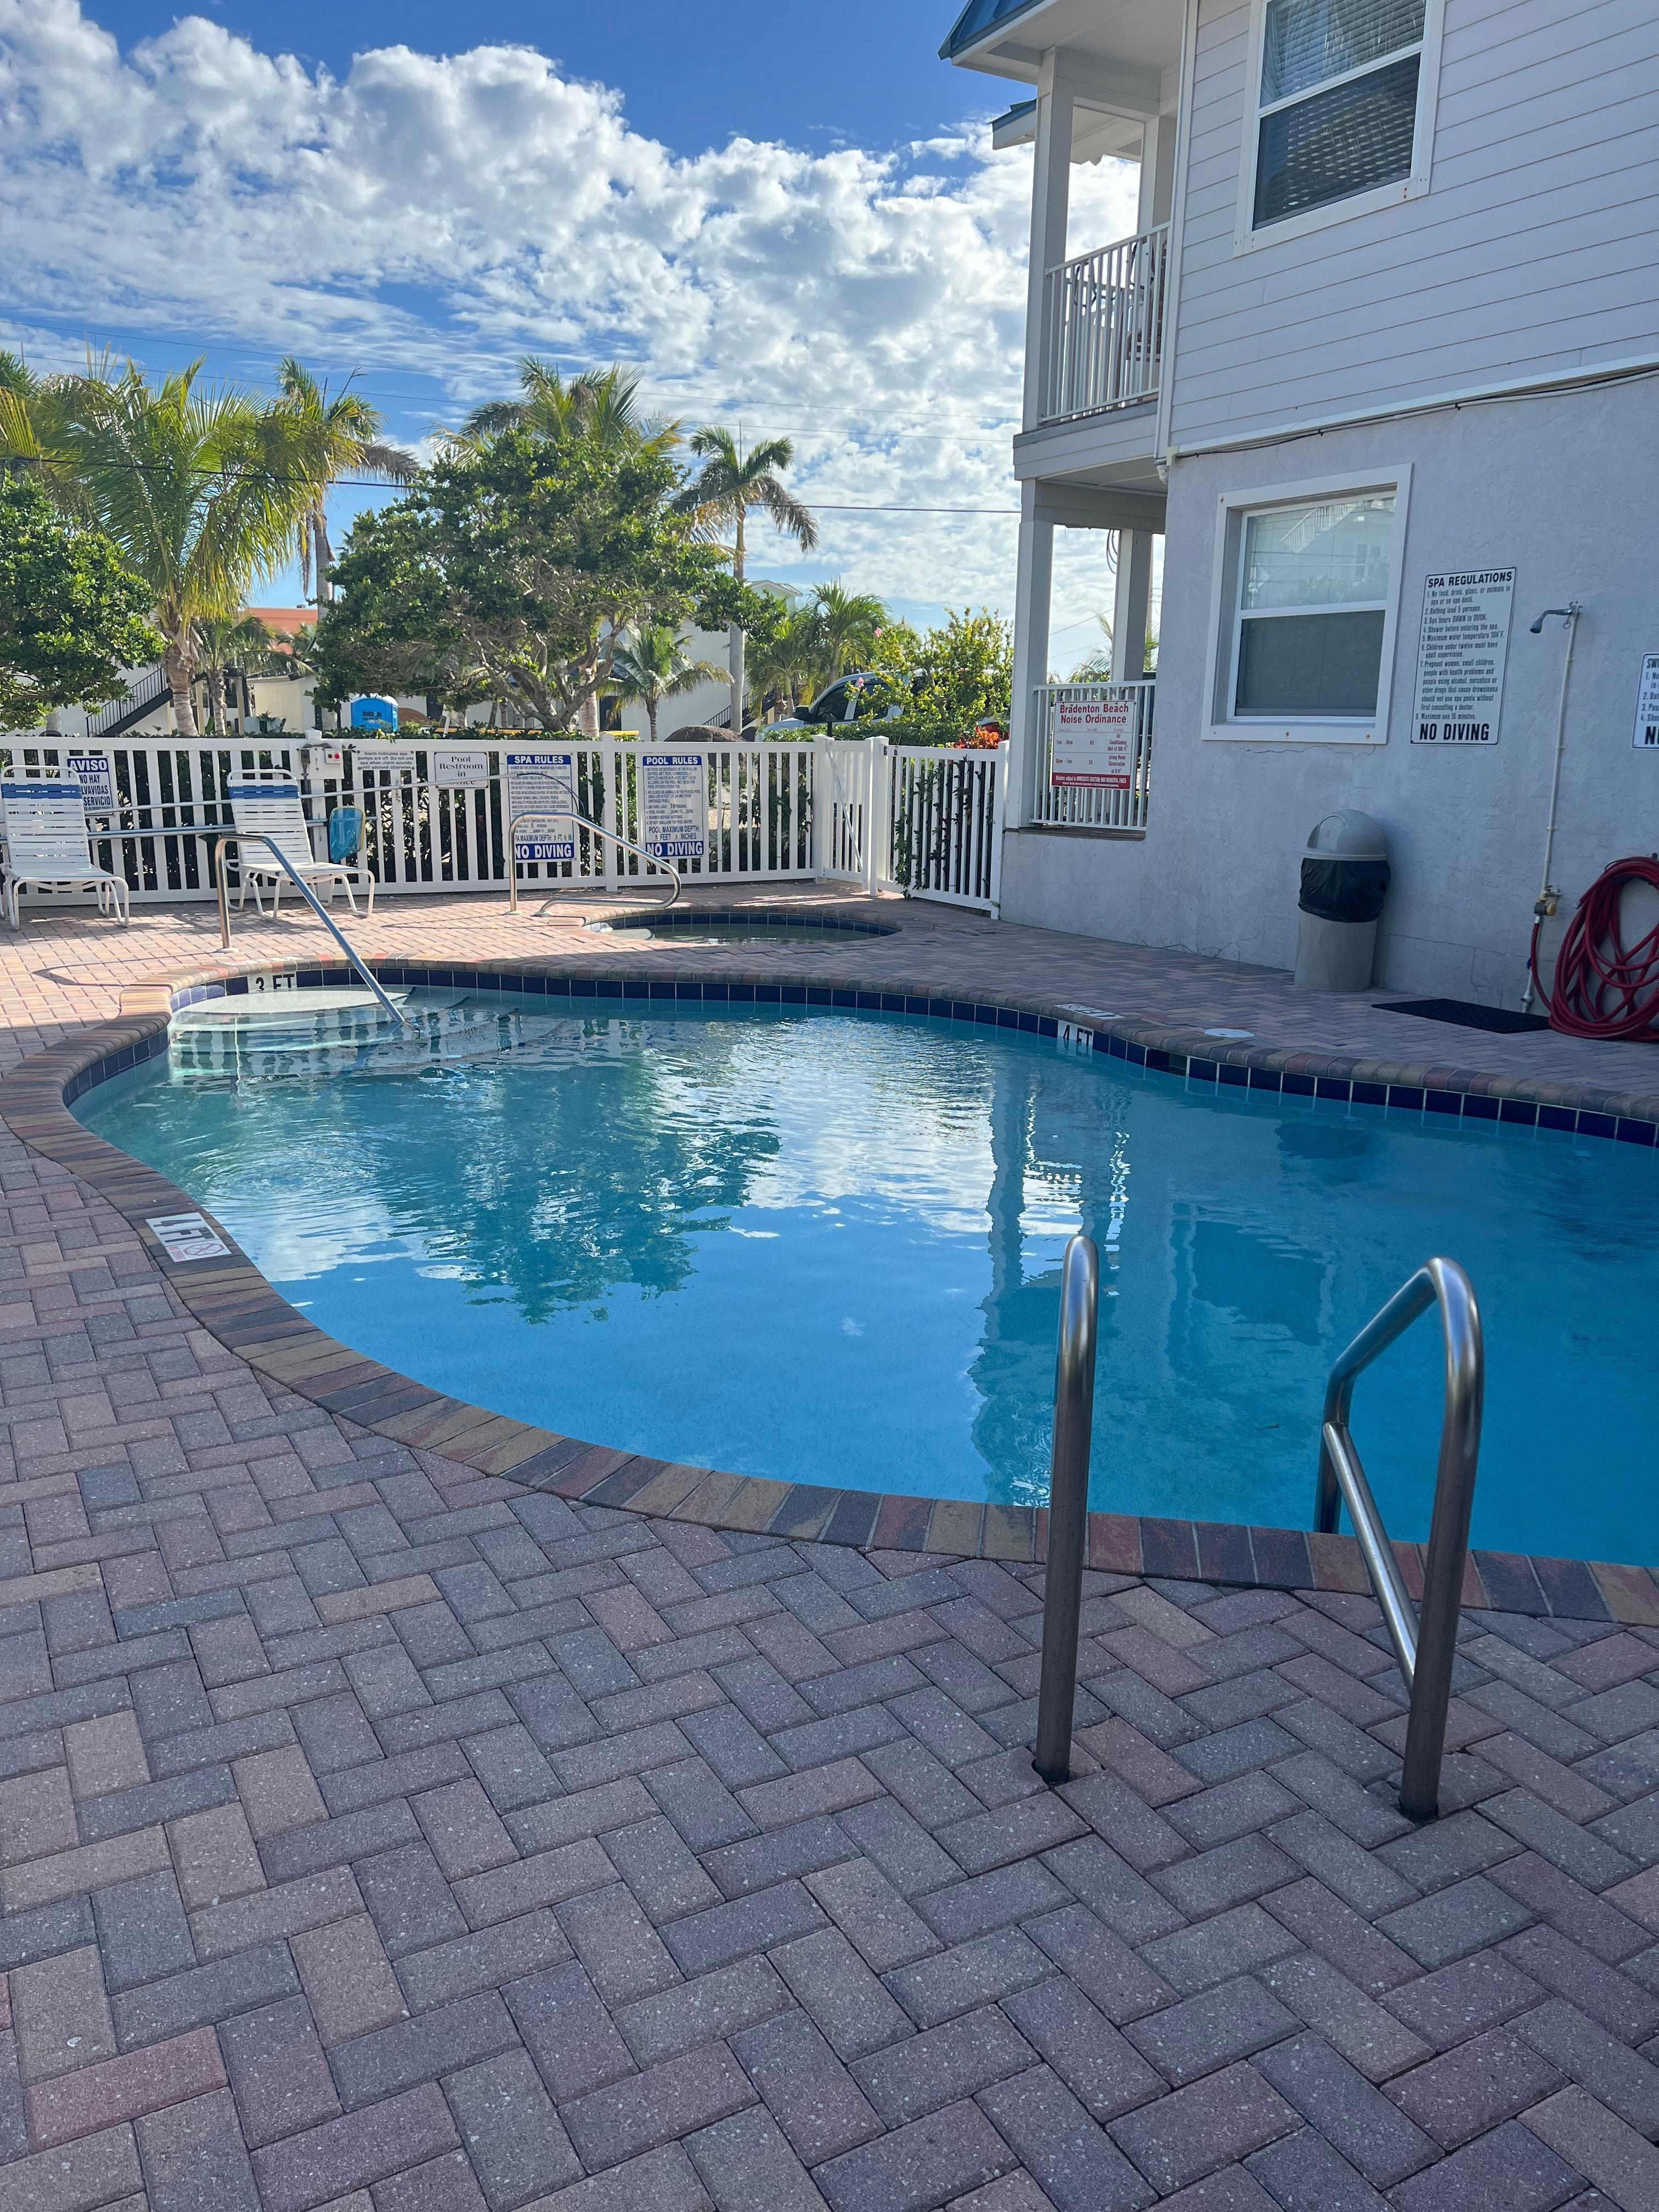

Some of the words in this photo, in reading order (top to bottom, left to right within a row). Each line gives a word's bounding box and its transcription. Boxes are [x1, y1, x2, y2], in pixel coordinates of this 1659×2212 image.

[1428, 578, 1444, 588] SPA
[1448, 572, 1512, 586] REGULATIONS
[1060, 704, 1099, 713] Bradenton
[1103, 703, 1128, 712] Beach
[1061, 715, 1082, 724] Noise
[1086, 714, 1126, 723] Ordinance
[1420, 723, 1437, 740] NO
[1443, 723, 1490, 741] DIVING
[70, 760, 108, 771] AVISO
[673, 757, 698, 765] RULES
[79, 775, 87, 783] NO
[89, 774, 100, 783] HAY
[81, 785, 108, 794] LVAVIDAS
[83, 797, 110, 806] SERVICIO
[516, 845, 529, 859] NO
[534, 844, 571, 857] DIVING
[647, 843, 662, 856] NO
[667, 842, 702, 855] DIVING
[256, 977, 264, 991] 3
[273, 973, 295, 989] FT
